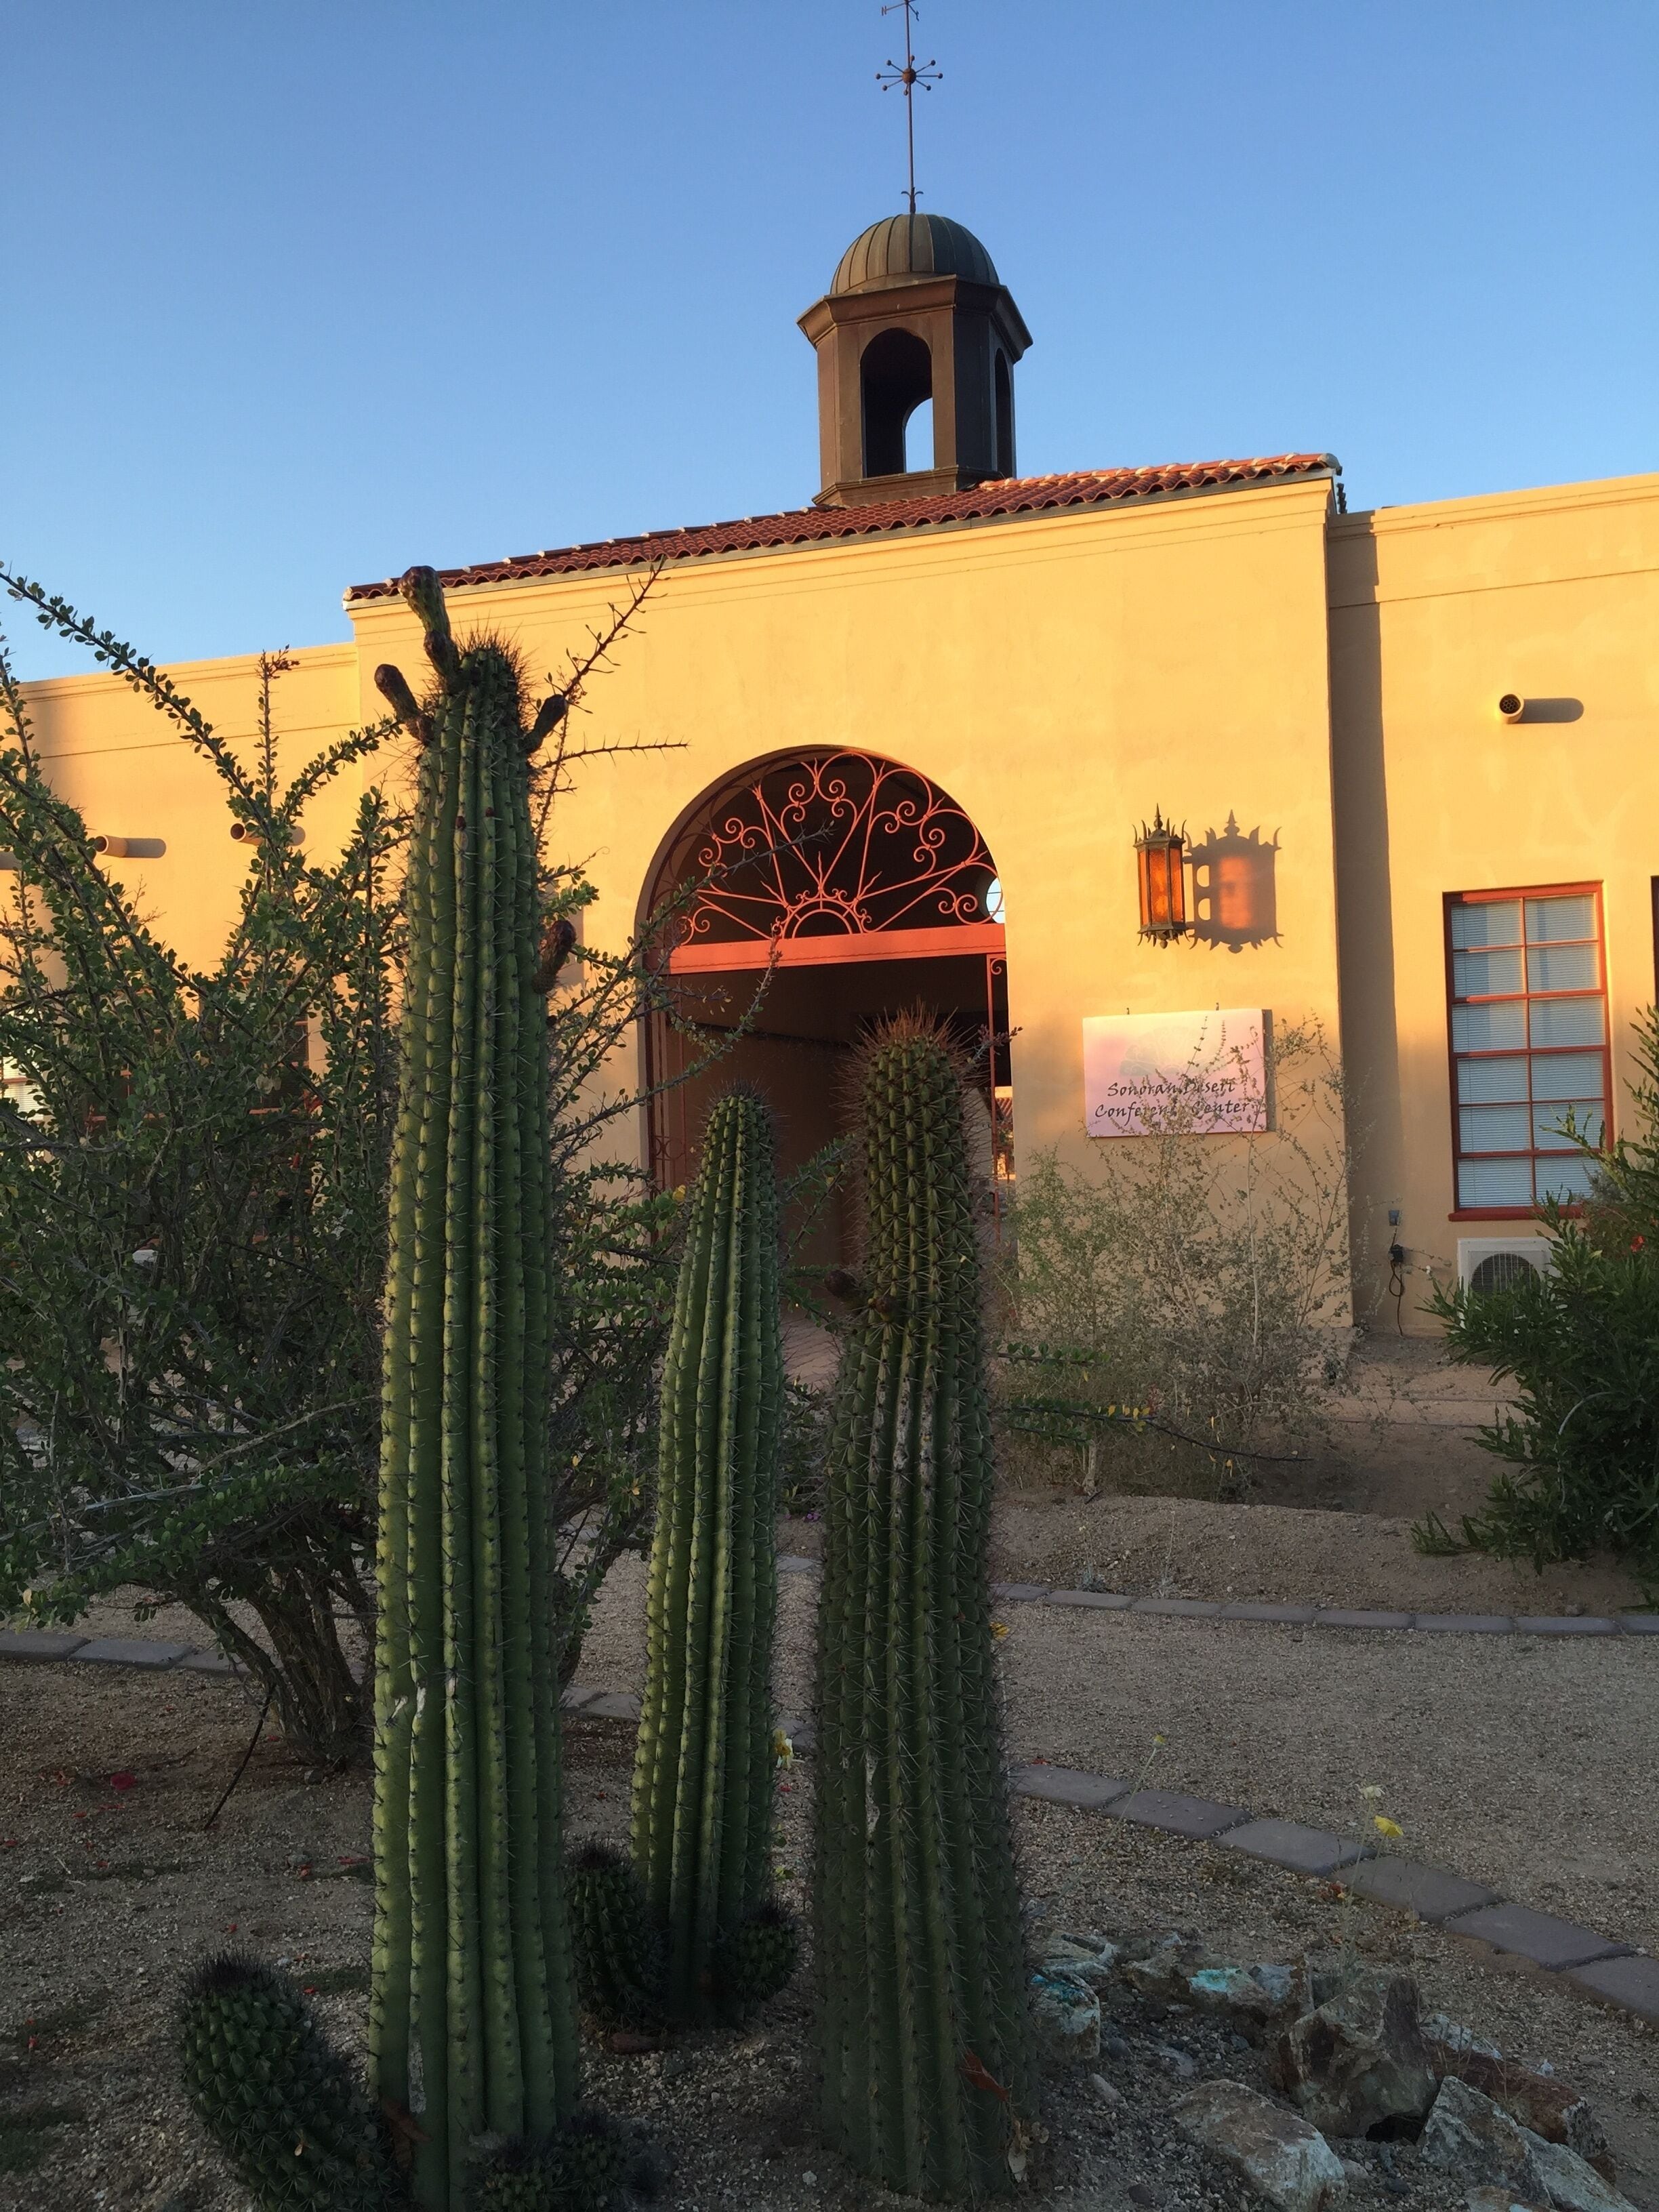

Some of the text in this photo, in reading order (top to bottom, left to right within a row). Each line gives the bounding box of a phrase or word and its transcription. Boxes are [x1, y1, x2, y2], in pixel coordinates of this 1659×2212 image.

[1107, 1082, 1177, 1097] Sonoran
[1095, 1100, 1250, 1126] Conferen Center
